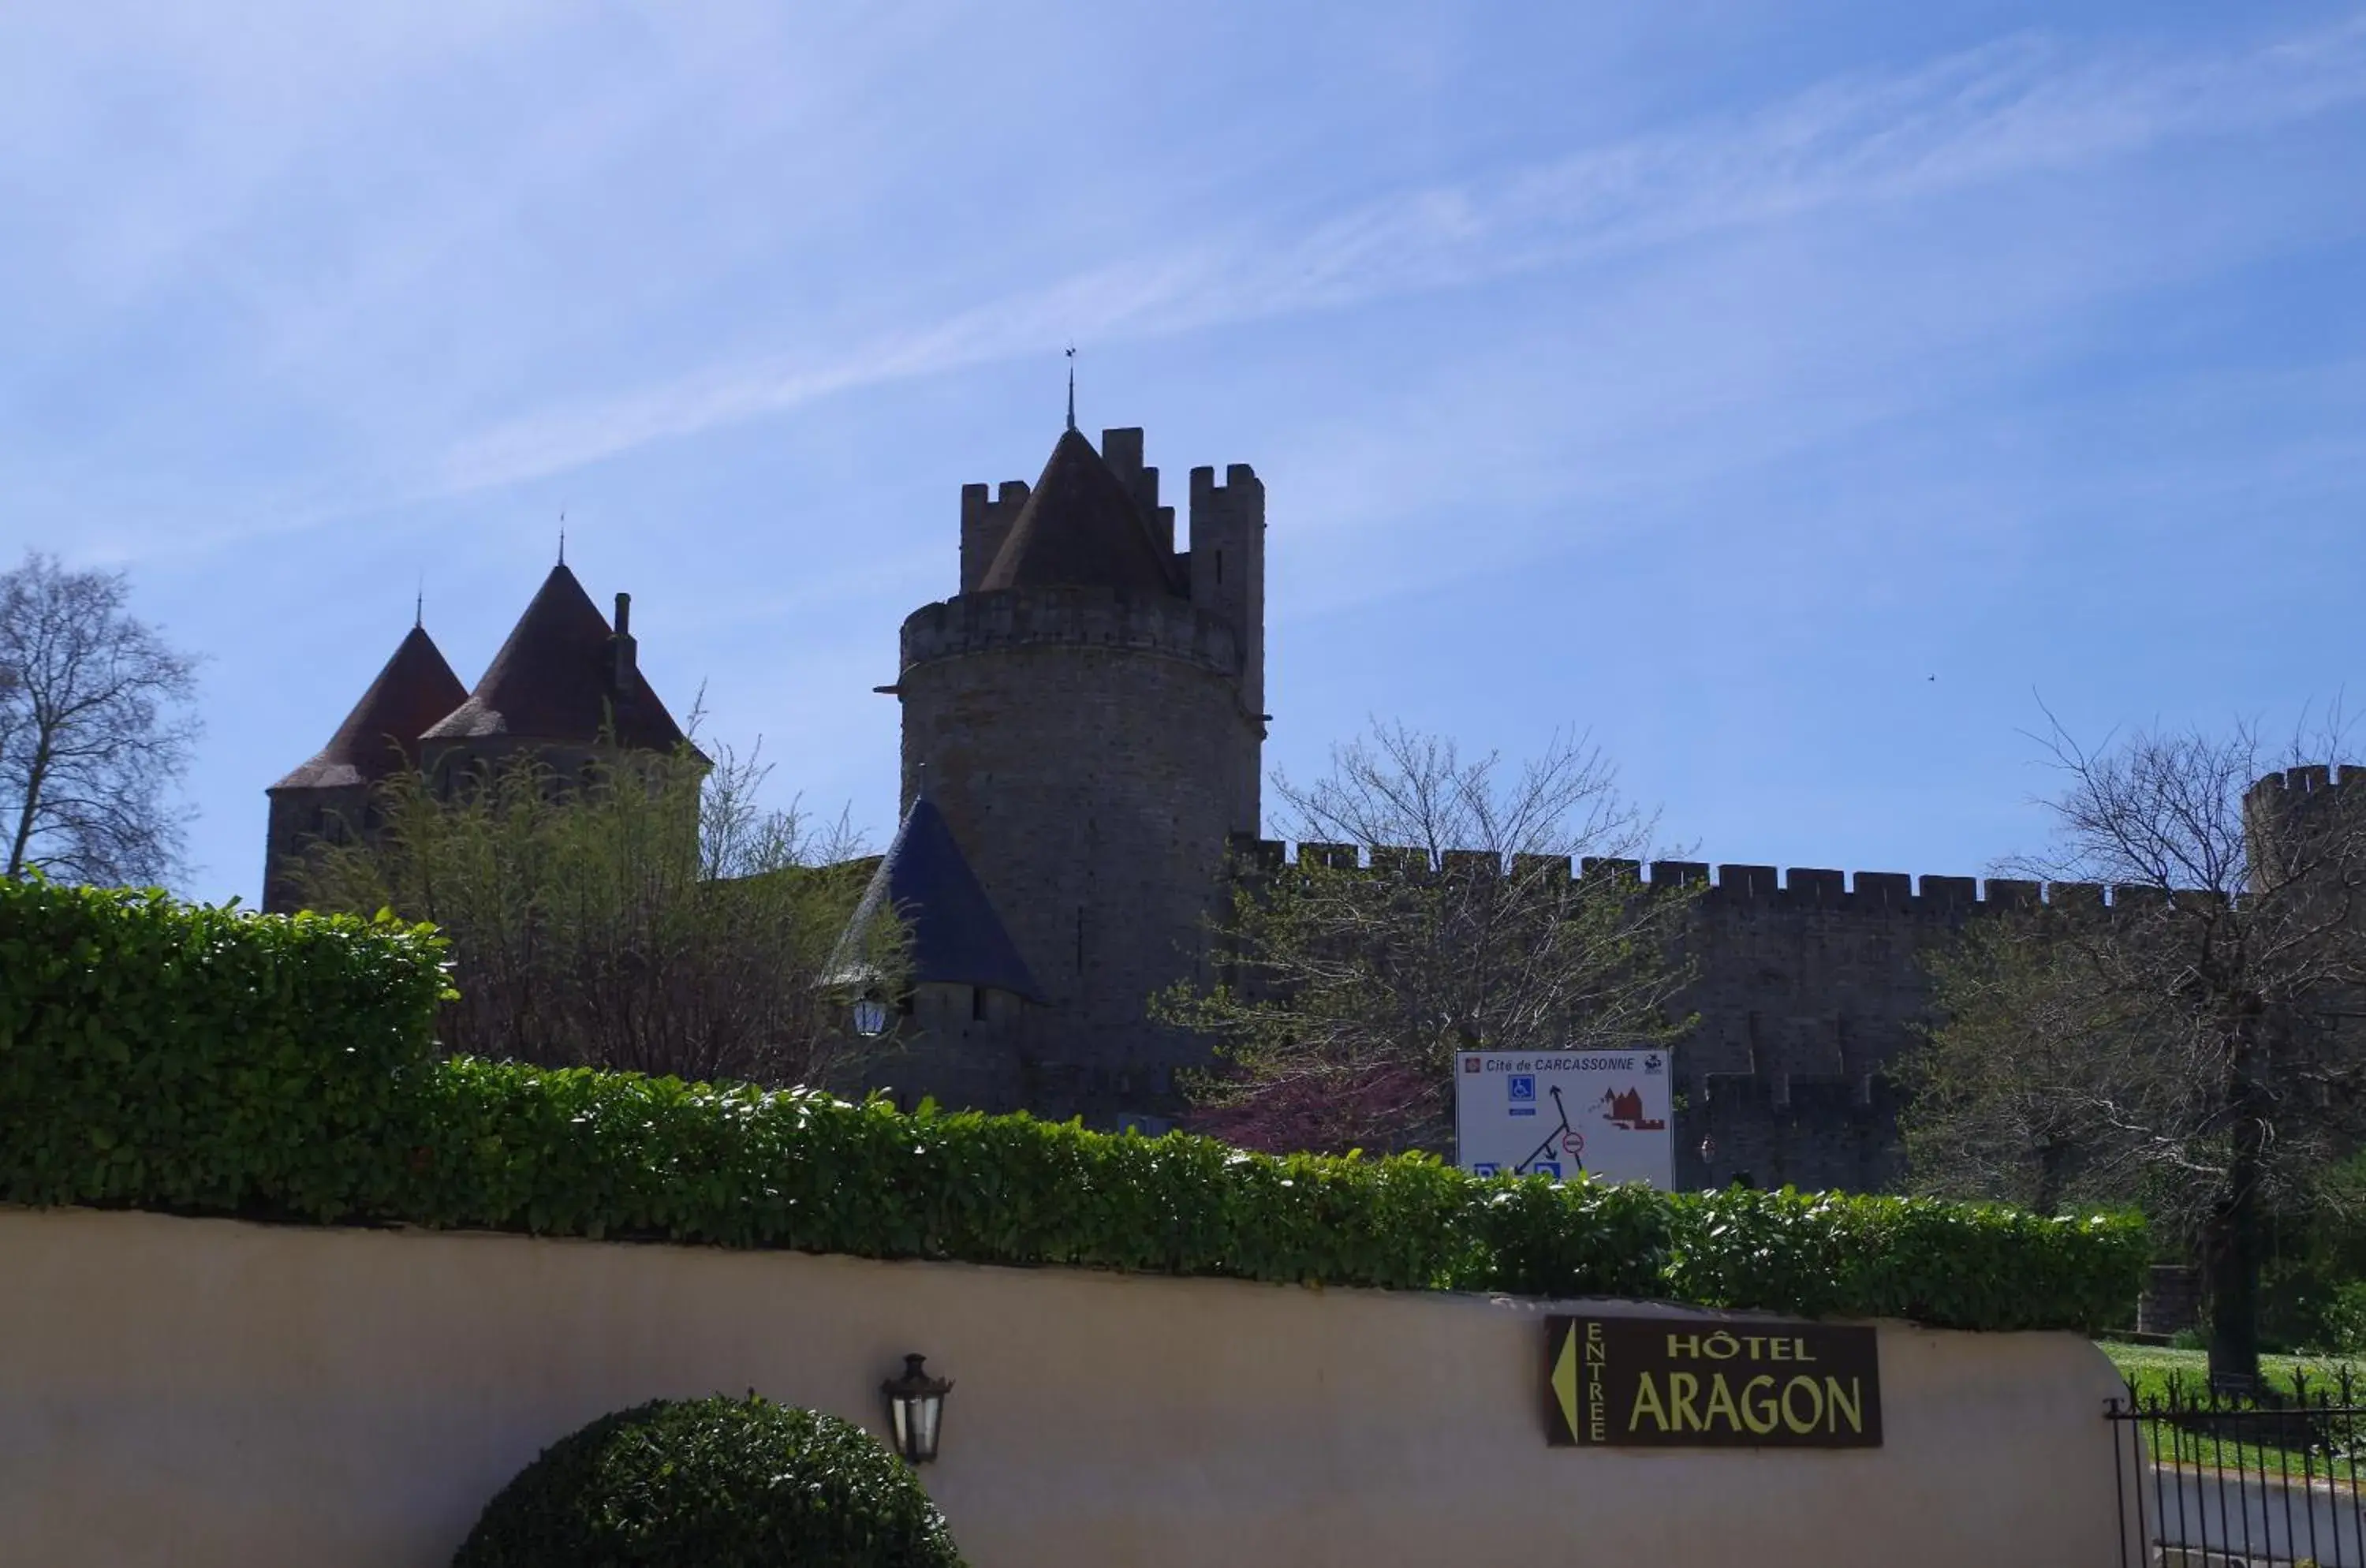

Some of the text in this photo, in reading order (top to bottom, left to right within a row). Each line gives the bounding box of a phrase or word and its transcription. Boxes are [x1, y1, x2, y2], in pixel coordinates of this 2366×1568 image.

[1517, 1059, 1532, 1070] de
[1535, 1057, 1635, 1071] CARCASSONNE
[1666, 1331, 1817, 1361] HÔTEL
[1585, 1323, 1606, 1442] ENTREE
[1629, 1371, 1862, 1434] ARAGON
